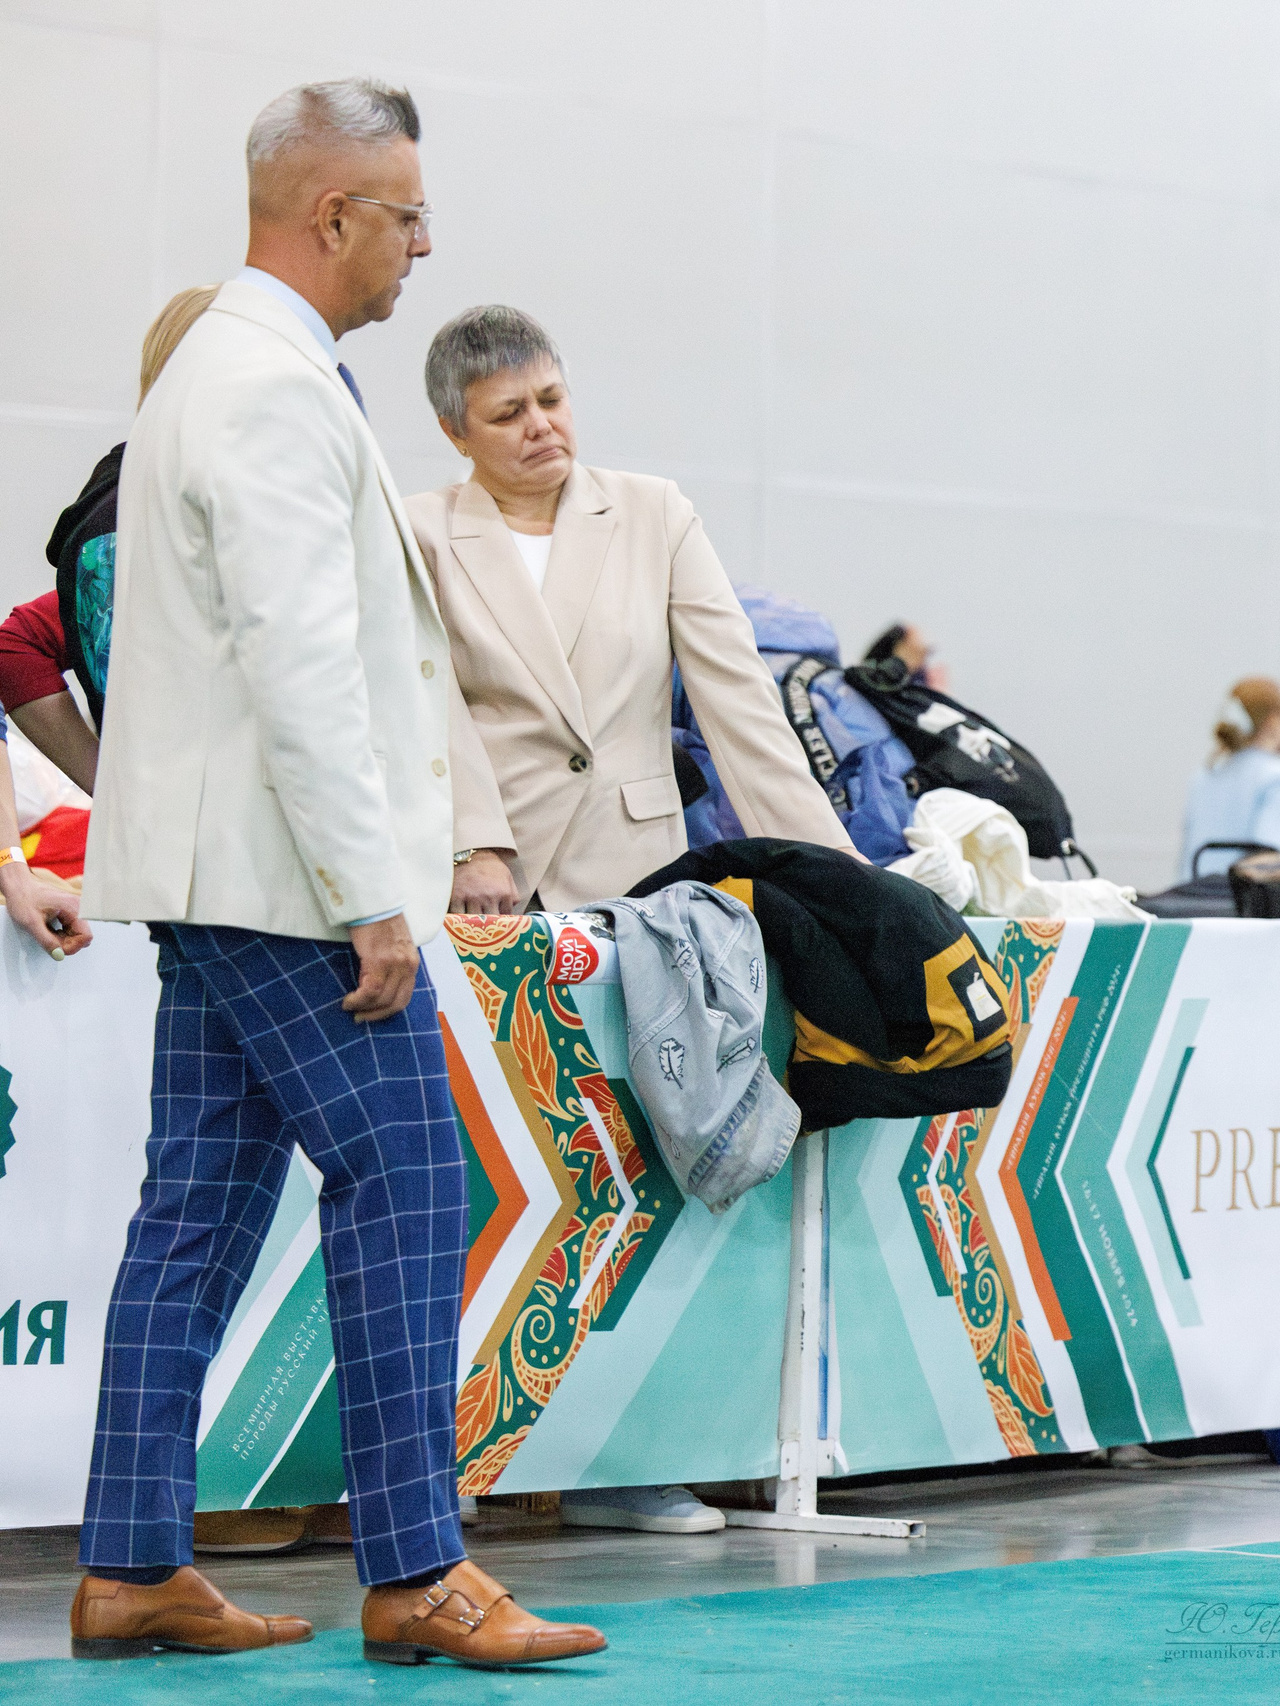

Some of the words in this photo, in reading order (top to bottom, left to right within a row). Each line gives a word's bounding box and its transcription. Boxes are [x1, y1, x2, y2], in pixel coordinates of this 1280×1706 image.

[557, 938, 574, 980] МОЙ
[569, 938, 591, 981] ДРУГ
[232, 1366, 284, 1453] ВСЕМИРНАЯ
[239, 1401, 279, 1461] ПОРОДЫ
[277, 1328, 319, 1396] РУССКИЙ
